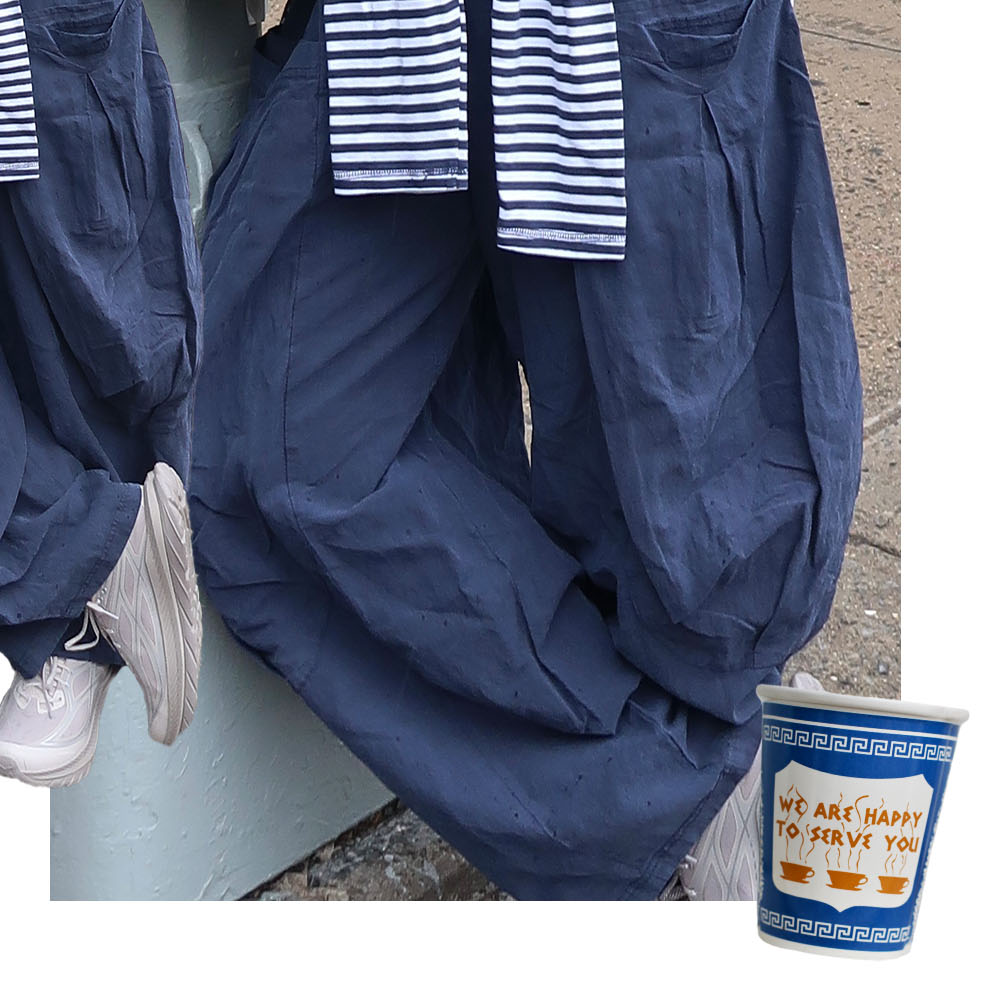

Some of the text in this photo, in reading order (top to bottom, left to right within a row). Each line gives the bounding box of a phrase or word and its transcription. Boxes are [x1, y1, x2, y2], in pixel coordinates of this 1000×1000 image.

[779, 795, 922, 828] WE ARE HAPPY
[776, 819, 920, 853] TO SERVE YOU
